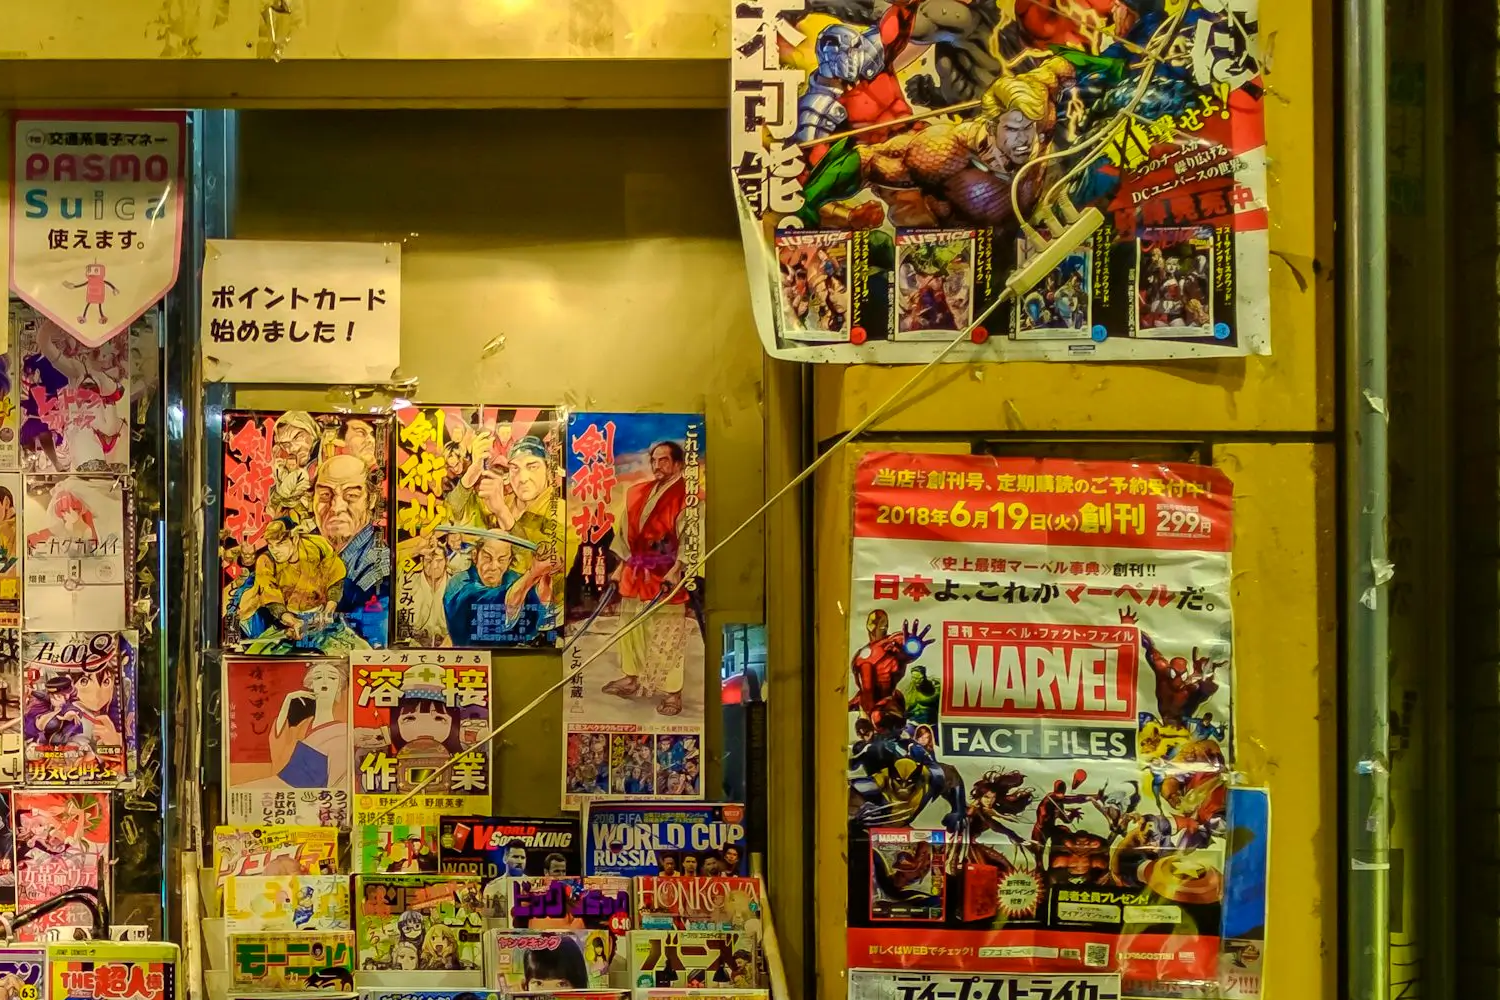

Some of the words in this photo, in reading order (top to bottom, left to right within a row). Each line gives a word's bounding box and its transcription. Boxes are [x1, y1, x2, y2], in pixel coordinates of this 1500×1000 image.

[50, 132, 168, 148] 交通系電子マネー
[25, 153, 168, 182] PASMO
[1129, 140, 1201, 182] 二つのチームが
[1174, 143, 1228, 174] 繰り広げる
[24, 188, 166, 221] Suica
[47, 228, 145, 250] 使えます。
[777, 231, 849, 247] JUSTICE
[898, 231, 972, 246] JUSTICE
[211, 285, 386, 311] ポイントカード
[210, 319, 355, 343] 始めました!
[571, 420, 617, 544] 剣術抄
[1156, 510, 1212, 536] 299円
[404, 560, 411, 568] 2
[872, 573, 1216, 613] 日本よ、これがマーベルだ。
[947, 625, 973, 638] 週刊
[979, 627, 1135, 642] マーベル・ファクト・ファイル
[362, 655, 481, 663] マンガでわかる
[357, 667, 489, 707] 溶接
[951, 644, 1127, 713] MARVEL
[951, 729, 1034, 755] FACT
[1044, 729, 1126, 757] FILES
[359, 751, 487, 791] 作業
[617, 813, 642, 824] FIFA
[534, 832, 572, 848] KING
[593, 823, 689, 850] WORLD
[691, 823, 744, 851] CUP
[878, 833, 908, 843] MARVEL
[593, 850, 658, 868] RUSSIA
[499, 936, 560, 950] ヤングキング
[869, 944, 974, 957] 詳しくはWEBでチェック!
[22, 988, 36, 998] 63
